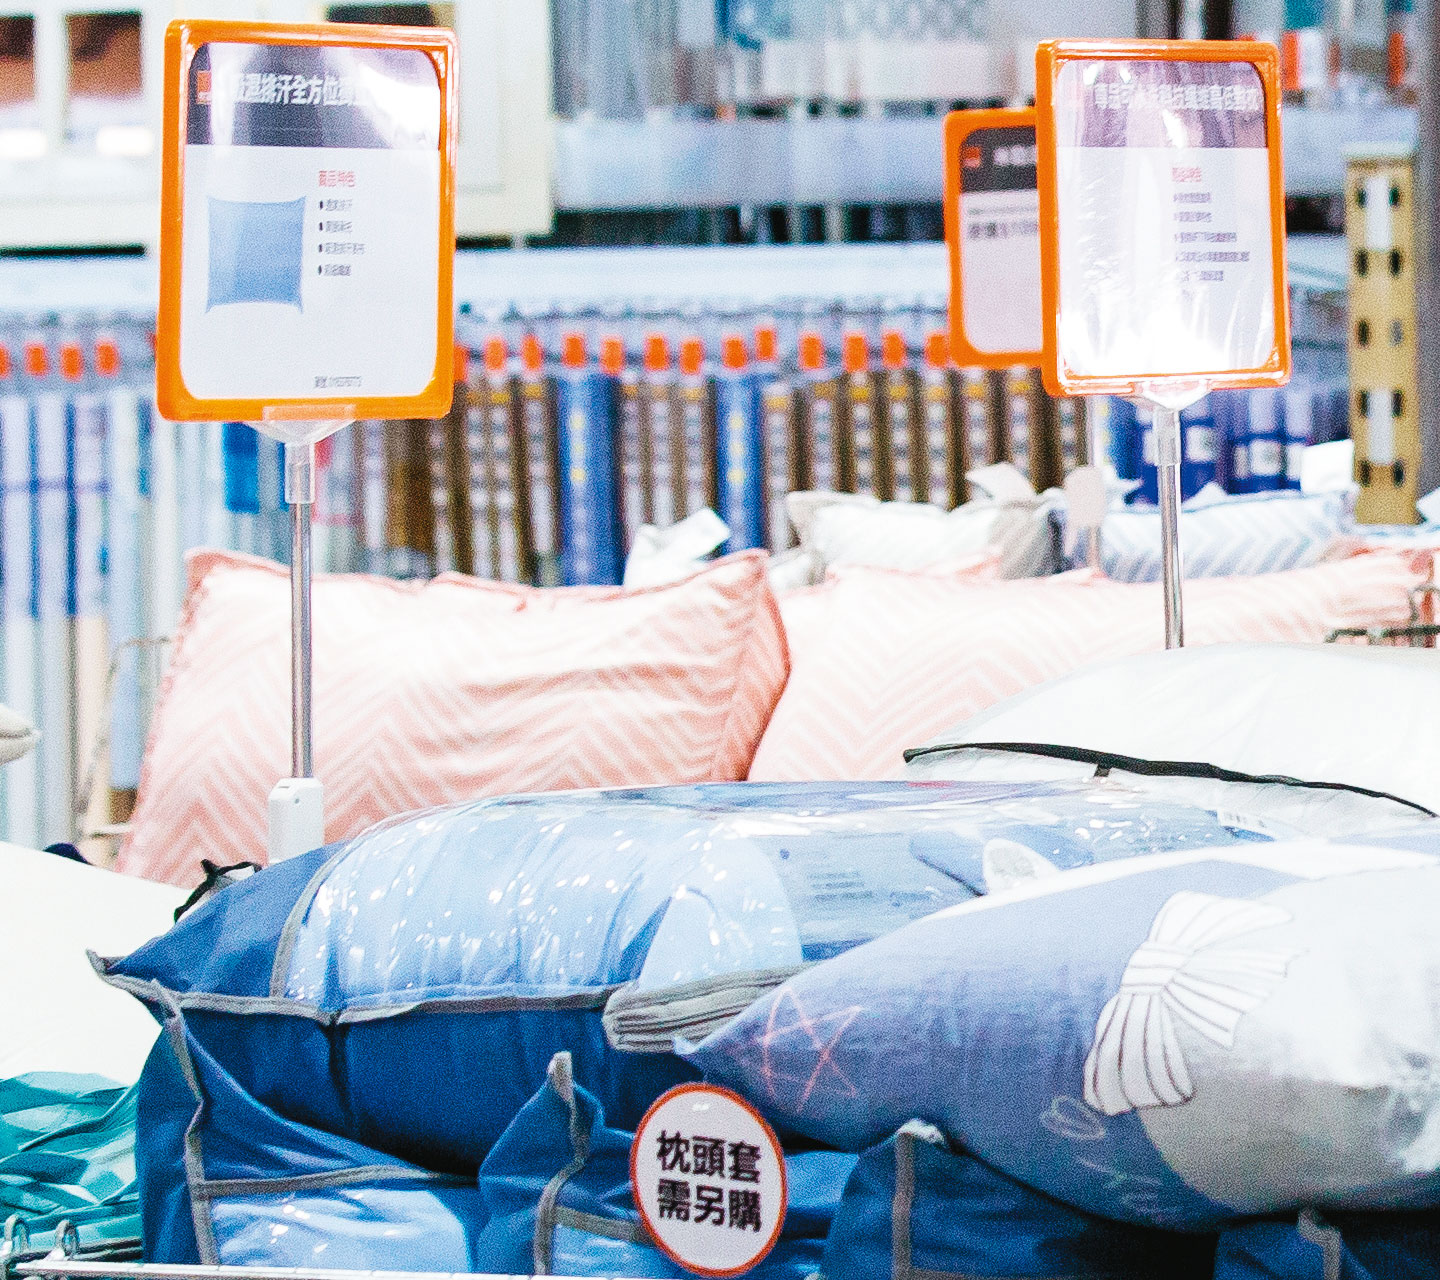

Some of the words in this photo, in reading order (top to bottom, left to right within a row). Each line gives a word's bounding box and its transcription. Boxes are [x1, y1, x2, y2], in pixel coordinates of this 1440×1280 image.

[656, 1129, 762, 1184] 枕頭套
[657, 1178, 763, 1233] 需另購
